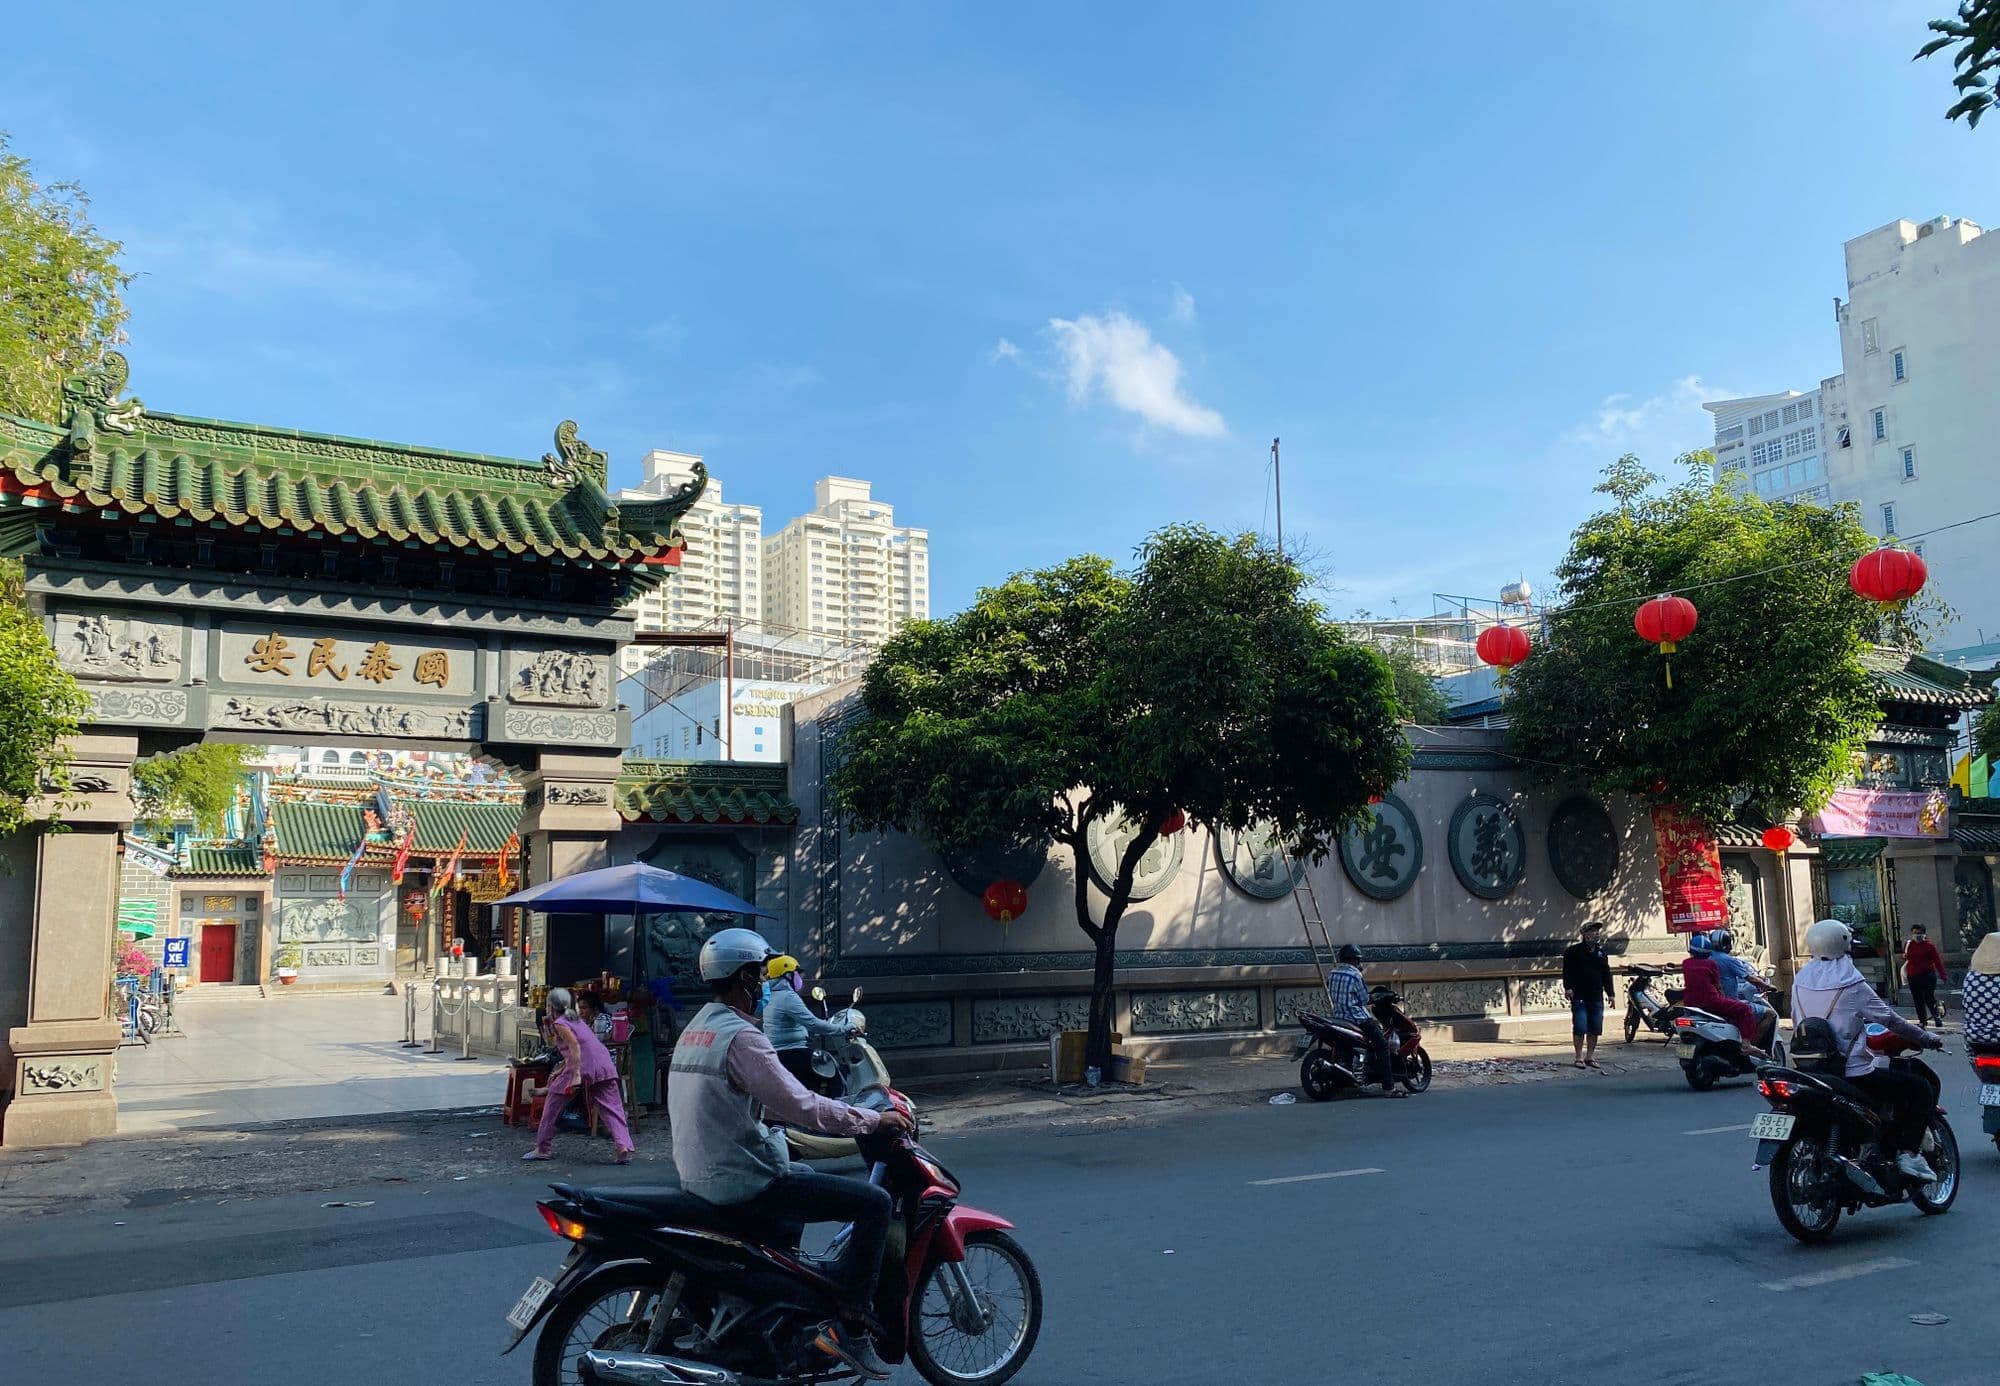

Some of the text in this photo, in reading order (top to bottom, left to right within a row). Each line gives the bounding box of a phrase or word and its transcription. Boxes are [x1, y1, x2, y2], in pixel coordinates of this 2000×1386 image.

[167, 953, 183, 963] XE
[1986, 1085, 2000, 1095] 59-
[1760, 1115, 1787, 1127] 59-E1
